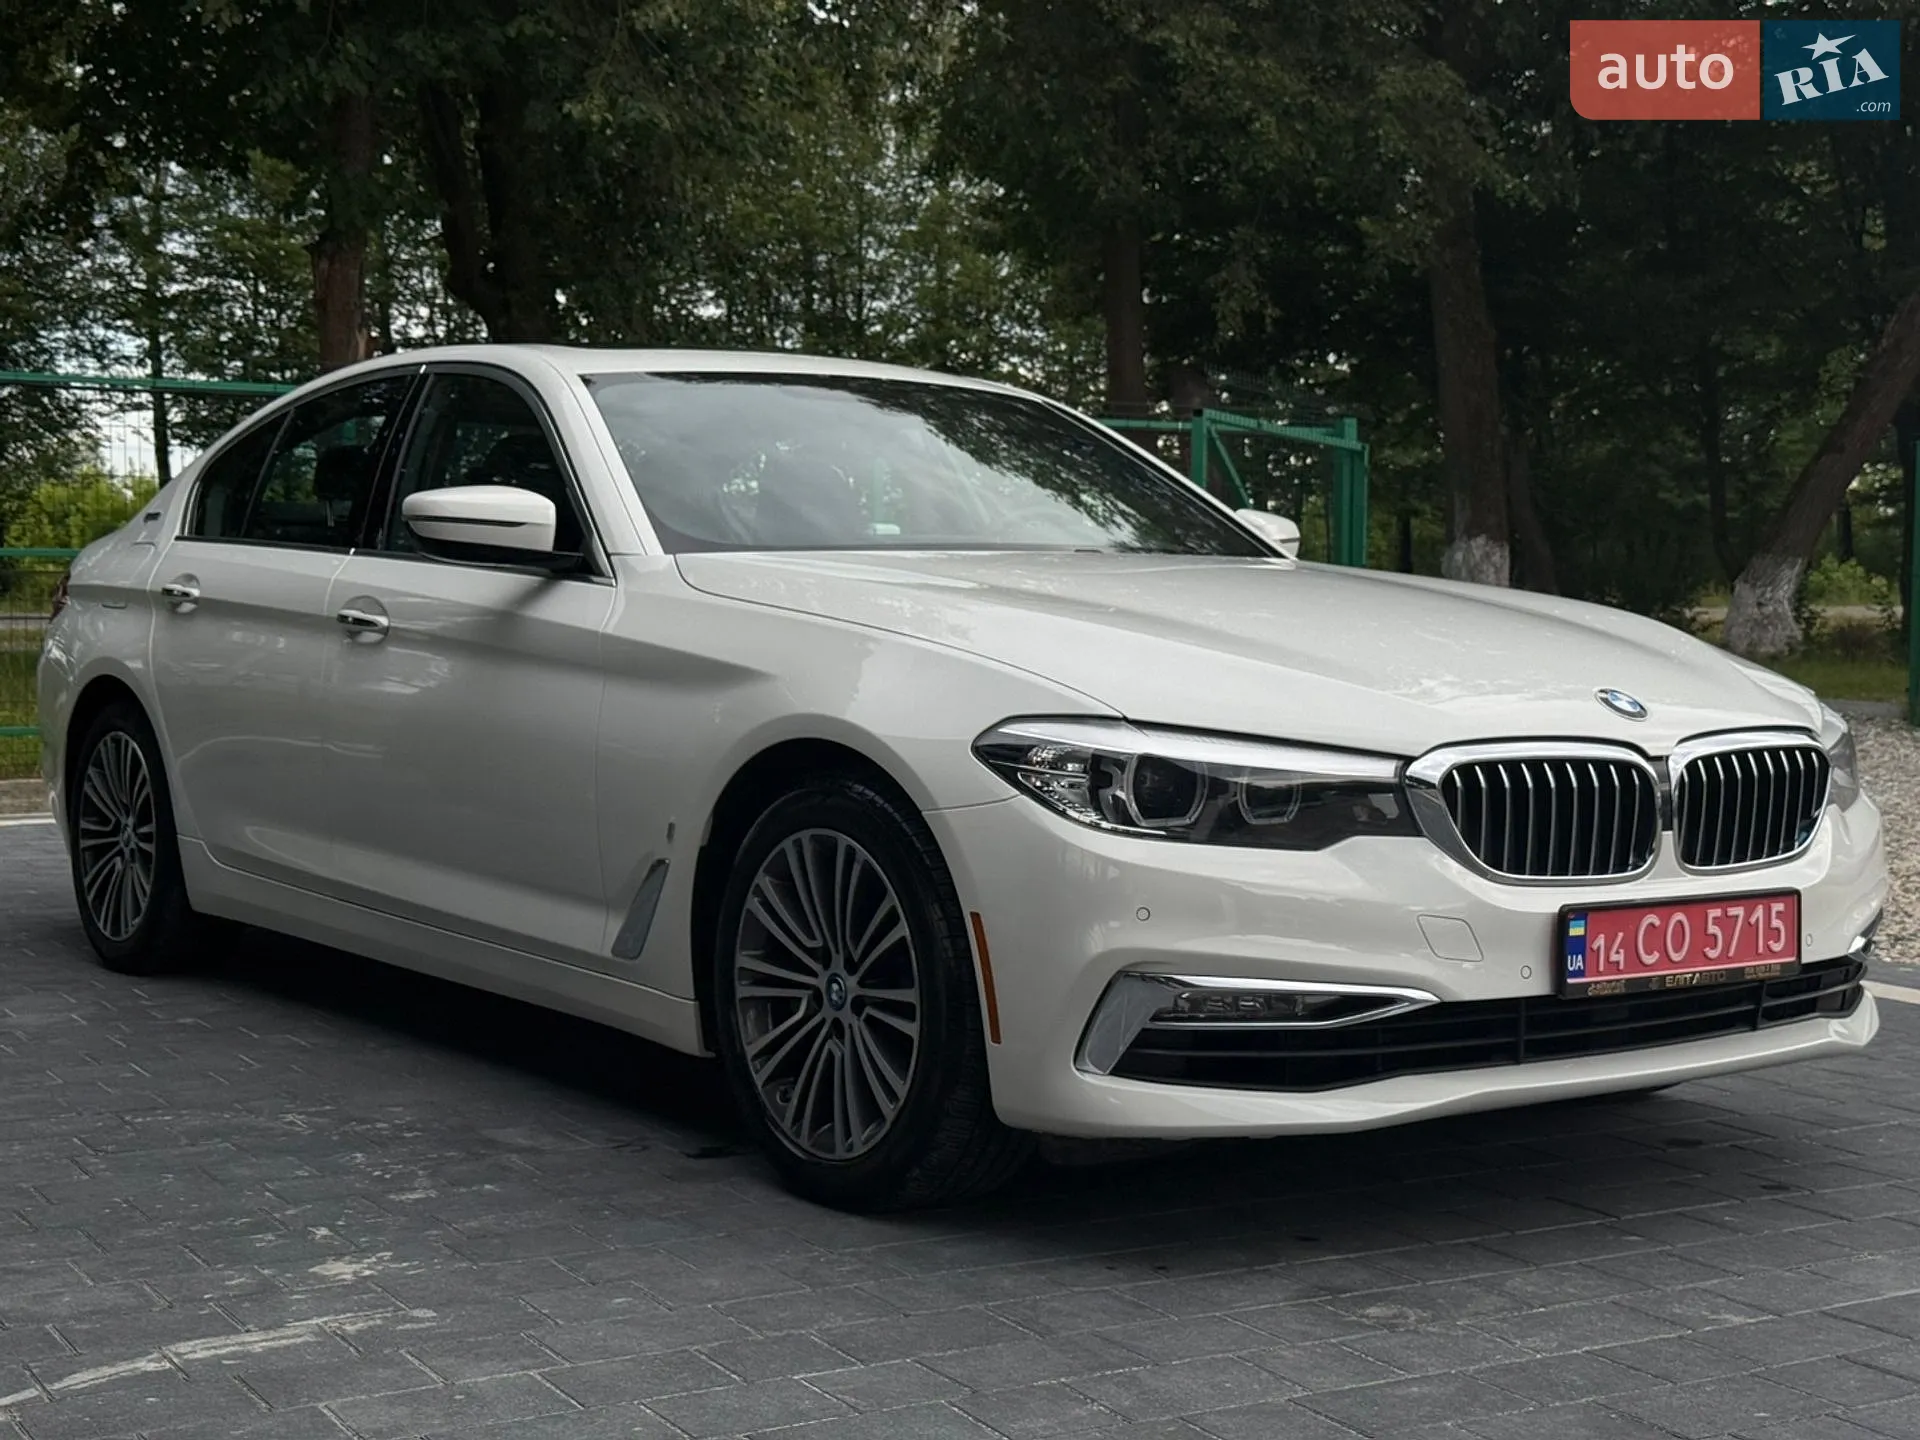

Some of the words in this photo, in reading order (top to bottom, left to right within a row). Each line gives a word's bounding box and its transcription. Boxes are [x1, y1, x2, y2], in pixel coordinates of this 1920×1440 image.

[1591, 931, 1625, 972] 14
[1636, 911, 1691, 966] CO
[1703, 902, 1786, 959] 5715
[1567, 954, 1584, 971] UA
